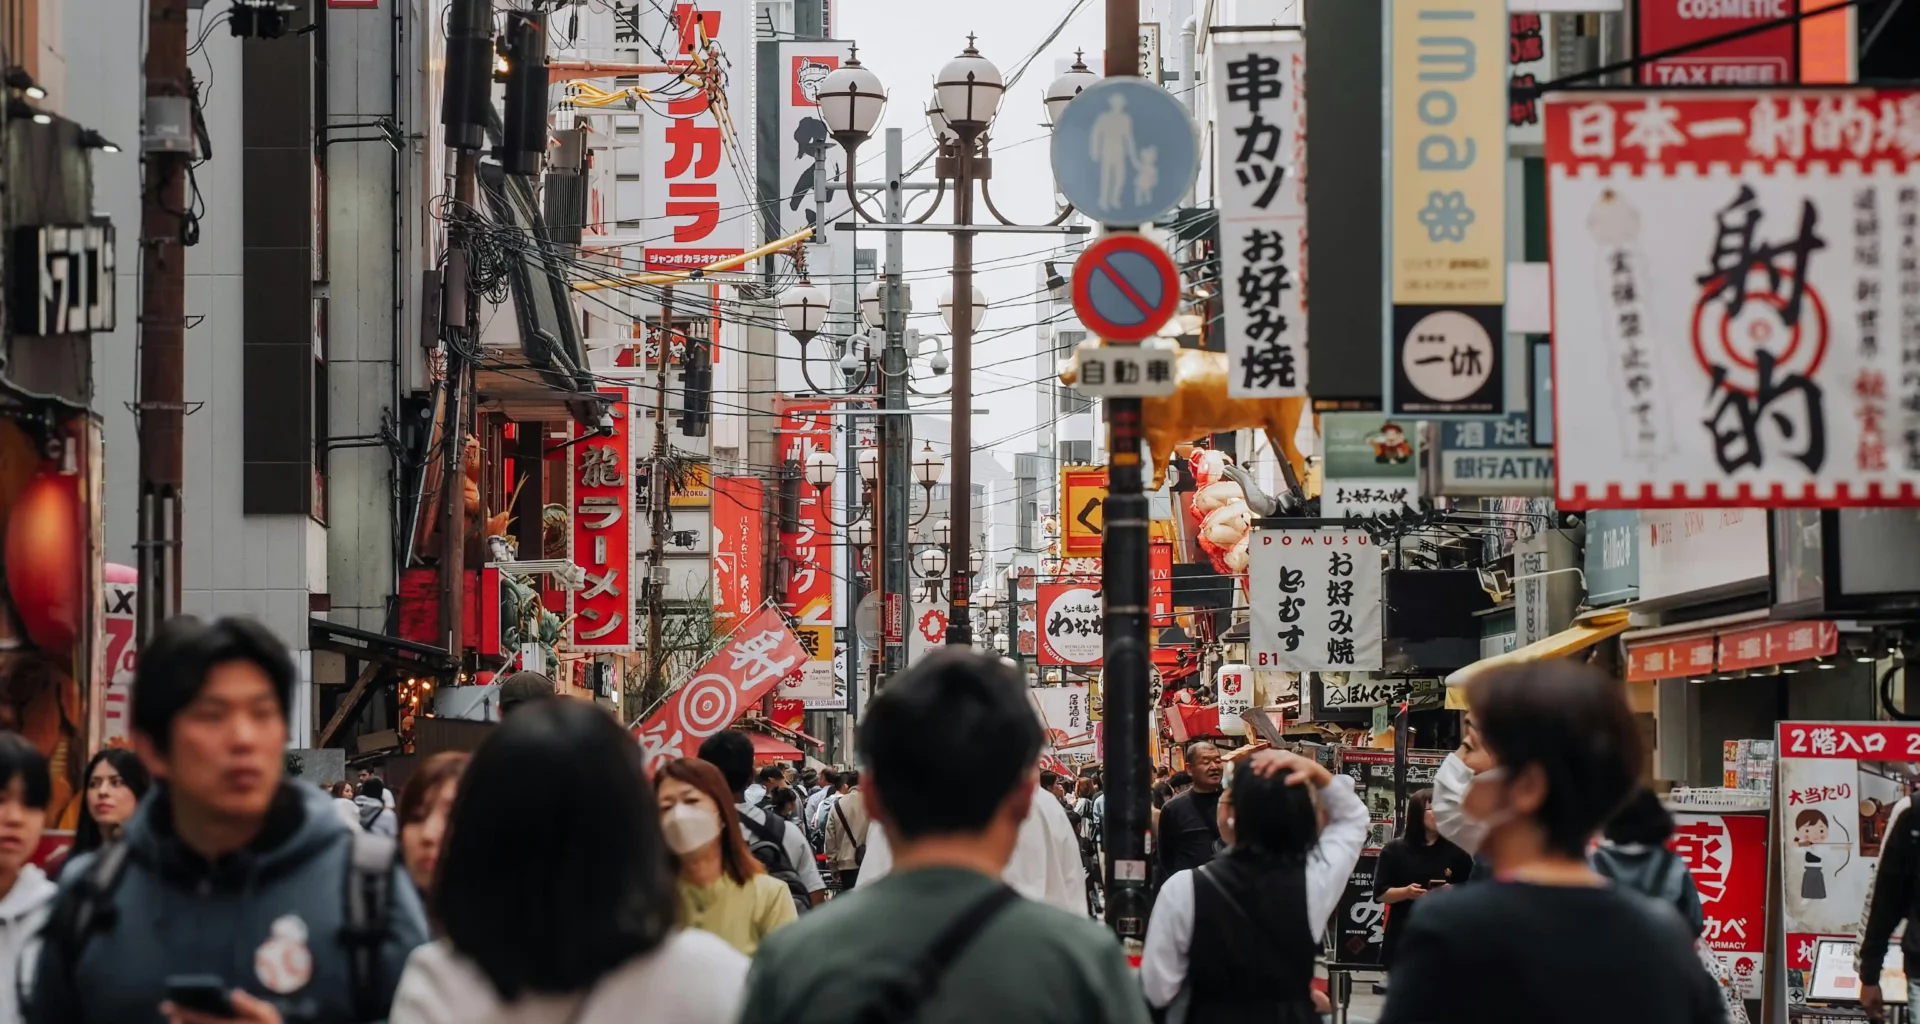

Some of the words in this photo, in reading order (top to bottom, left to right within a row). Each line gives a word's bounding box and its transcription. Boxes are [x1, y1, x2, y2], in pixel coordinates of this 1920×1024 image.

[1226, 53, 1284, 209] 串カツ
[1238, 228, 1296, 389] お好み焼
[1696, 185, 1828, 475] 射的
[1082, 359, 1170, 385] 自動車
[1414, 344, 1483, 377] 一休
[790, 410, 821, 595] ツルドラッグ
[1336, 486, 1408, 505] お好み焼
[1263, 535, 1367, 546] DOMUSU
[1327, 551, 1355, 665] お好み焼
[1258, 652, 1279, 666] B1
[1790, 727, 1888, 756] 2階入口
[1788, 783, 1851, 806] 大当たり
[1707, 940, 1747, 950] ARMACY
